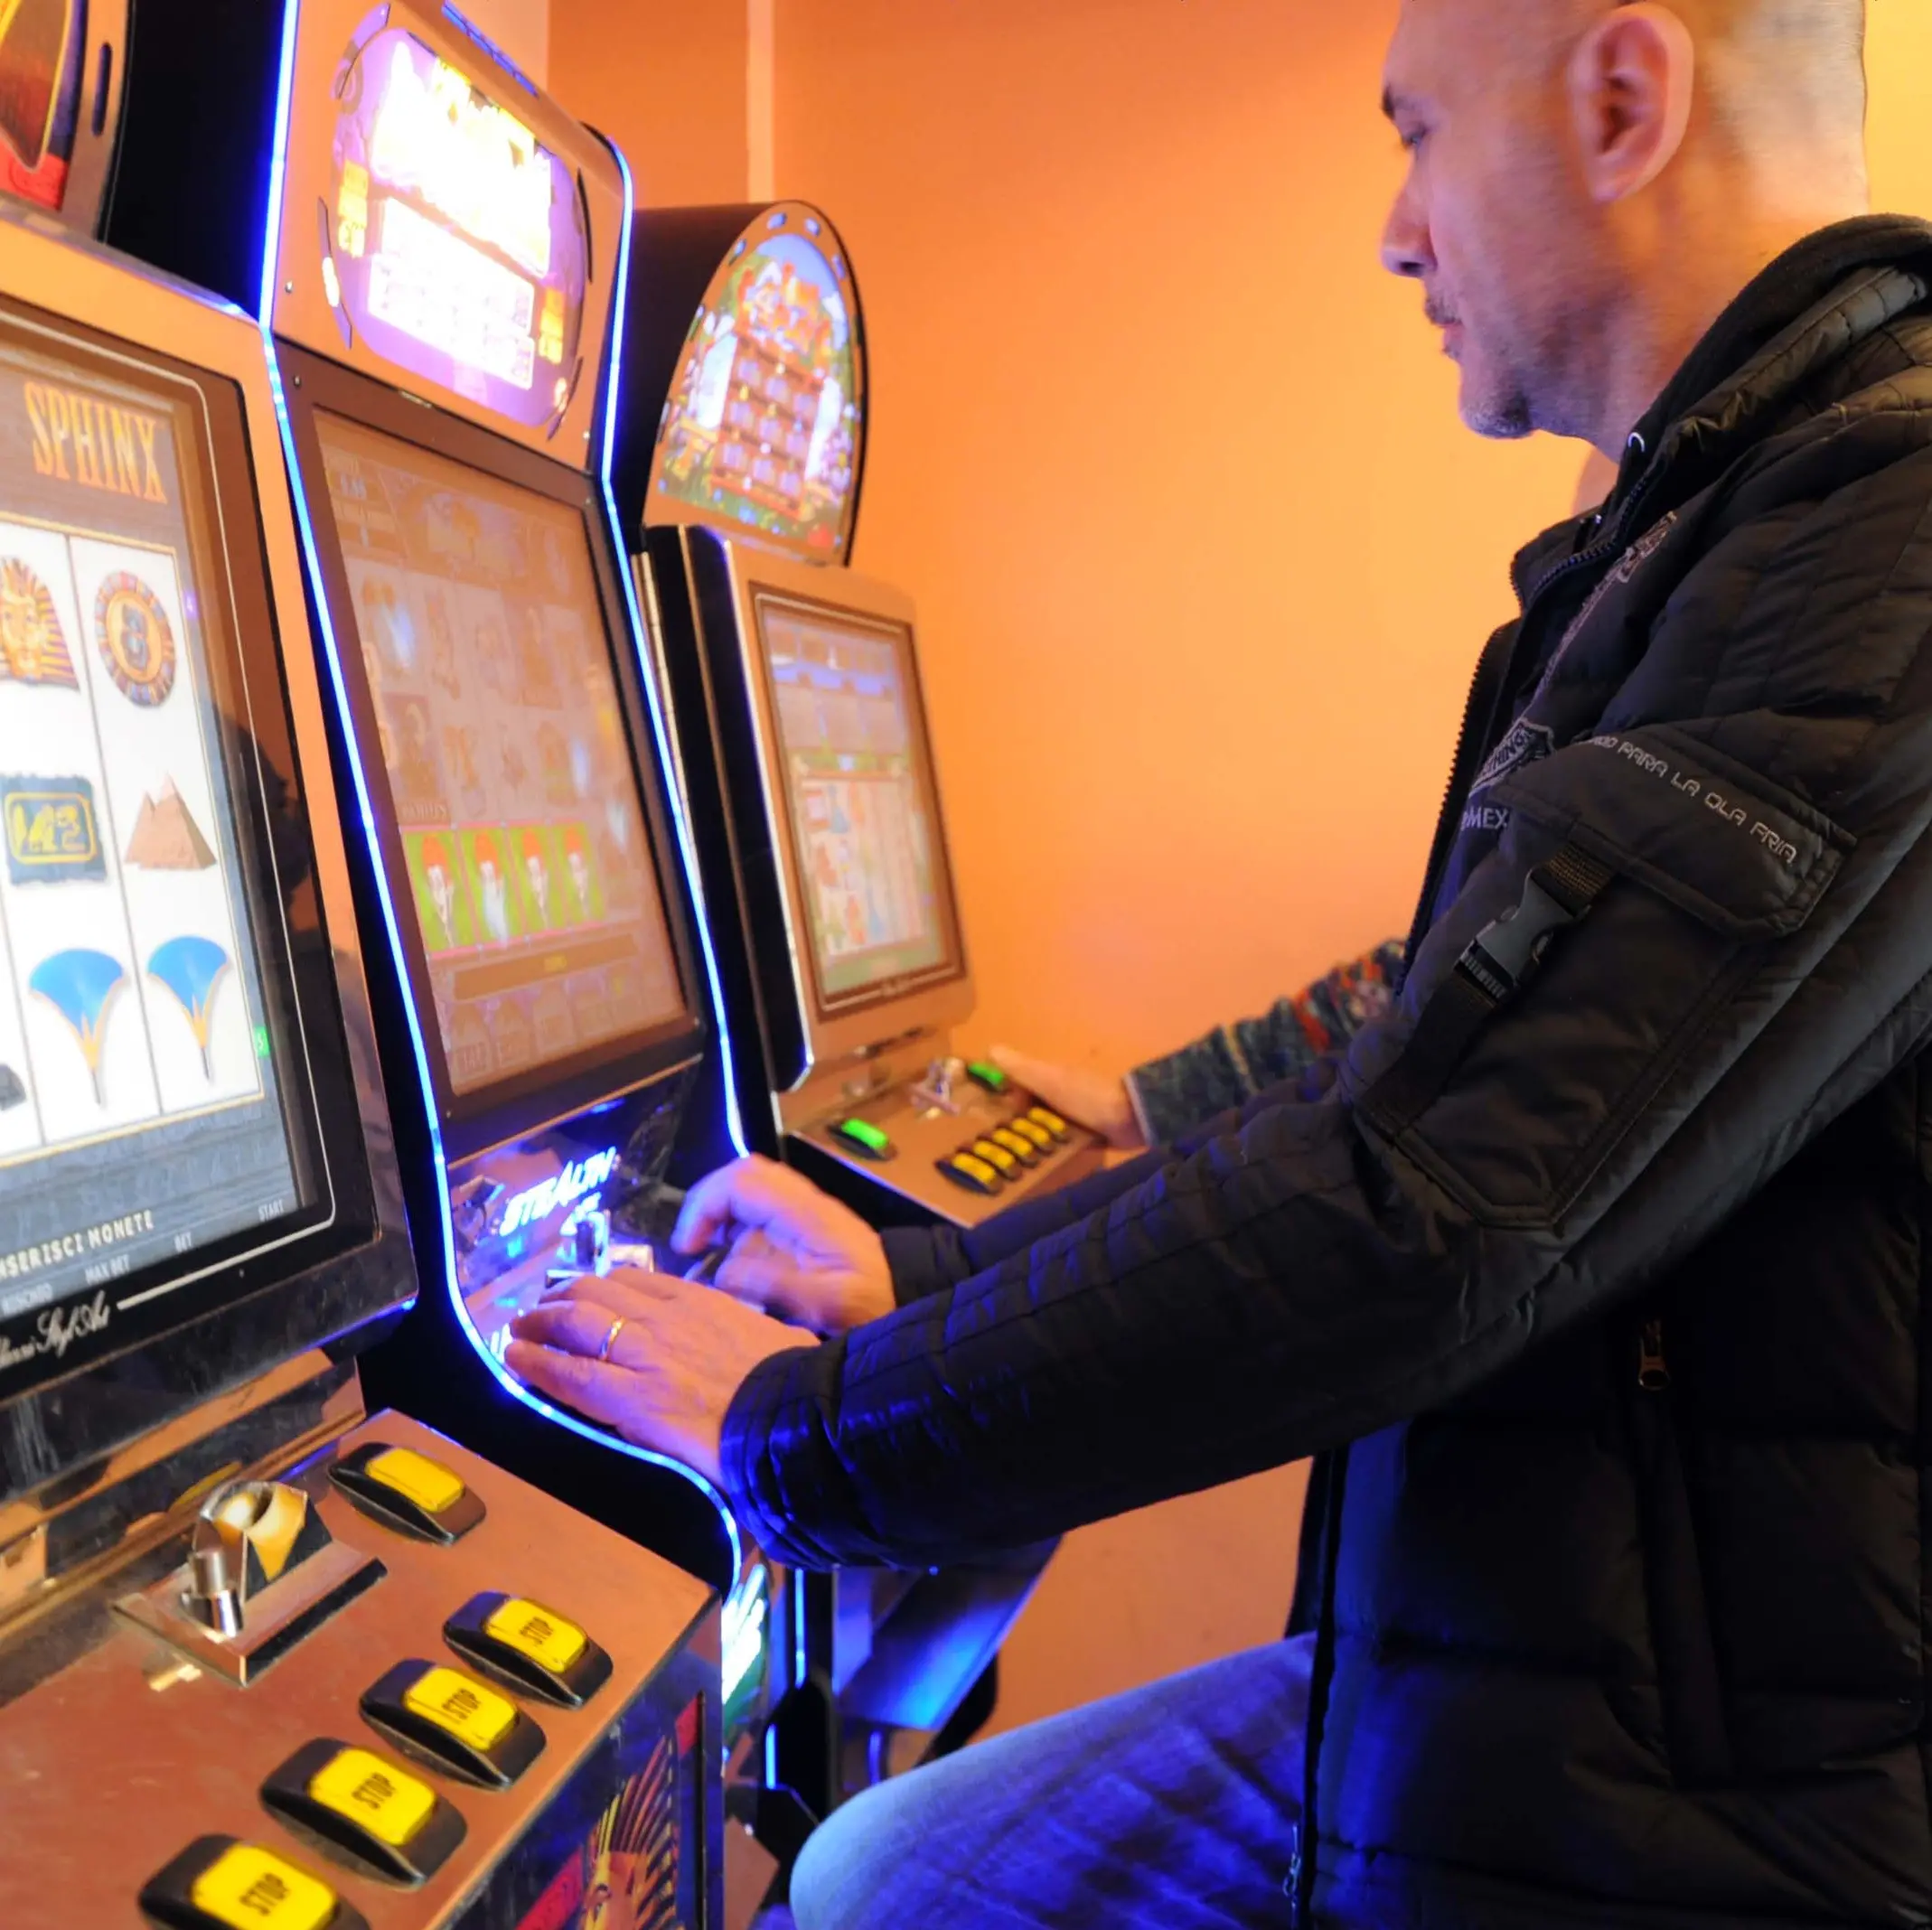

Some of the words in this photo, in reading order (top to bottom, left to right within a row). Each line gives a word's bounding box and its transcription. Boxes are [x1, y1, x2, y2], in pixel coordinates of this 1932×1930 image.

[24, 380, 167, 504] SPHINX
[1617, 741, 1668, 778] PARA
[1671, 771, 1701, 797] LA
[1704, 792, 1748, 827] OLA
[1749, 821, 1798, 867] FRIA
[88, 1210, 154, 1249] MONETE
[519, 1616, 553, 1645] STOP
[442, 1688, 481, 1720] STOP
[352, 1773, 397, 1810] STOP
[239, 1872, 290, 1916] STOP
